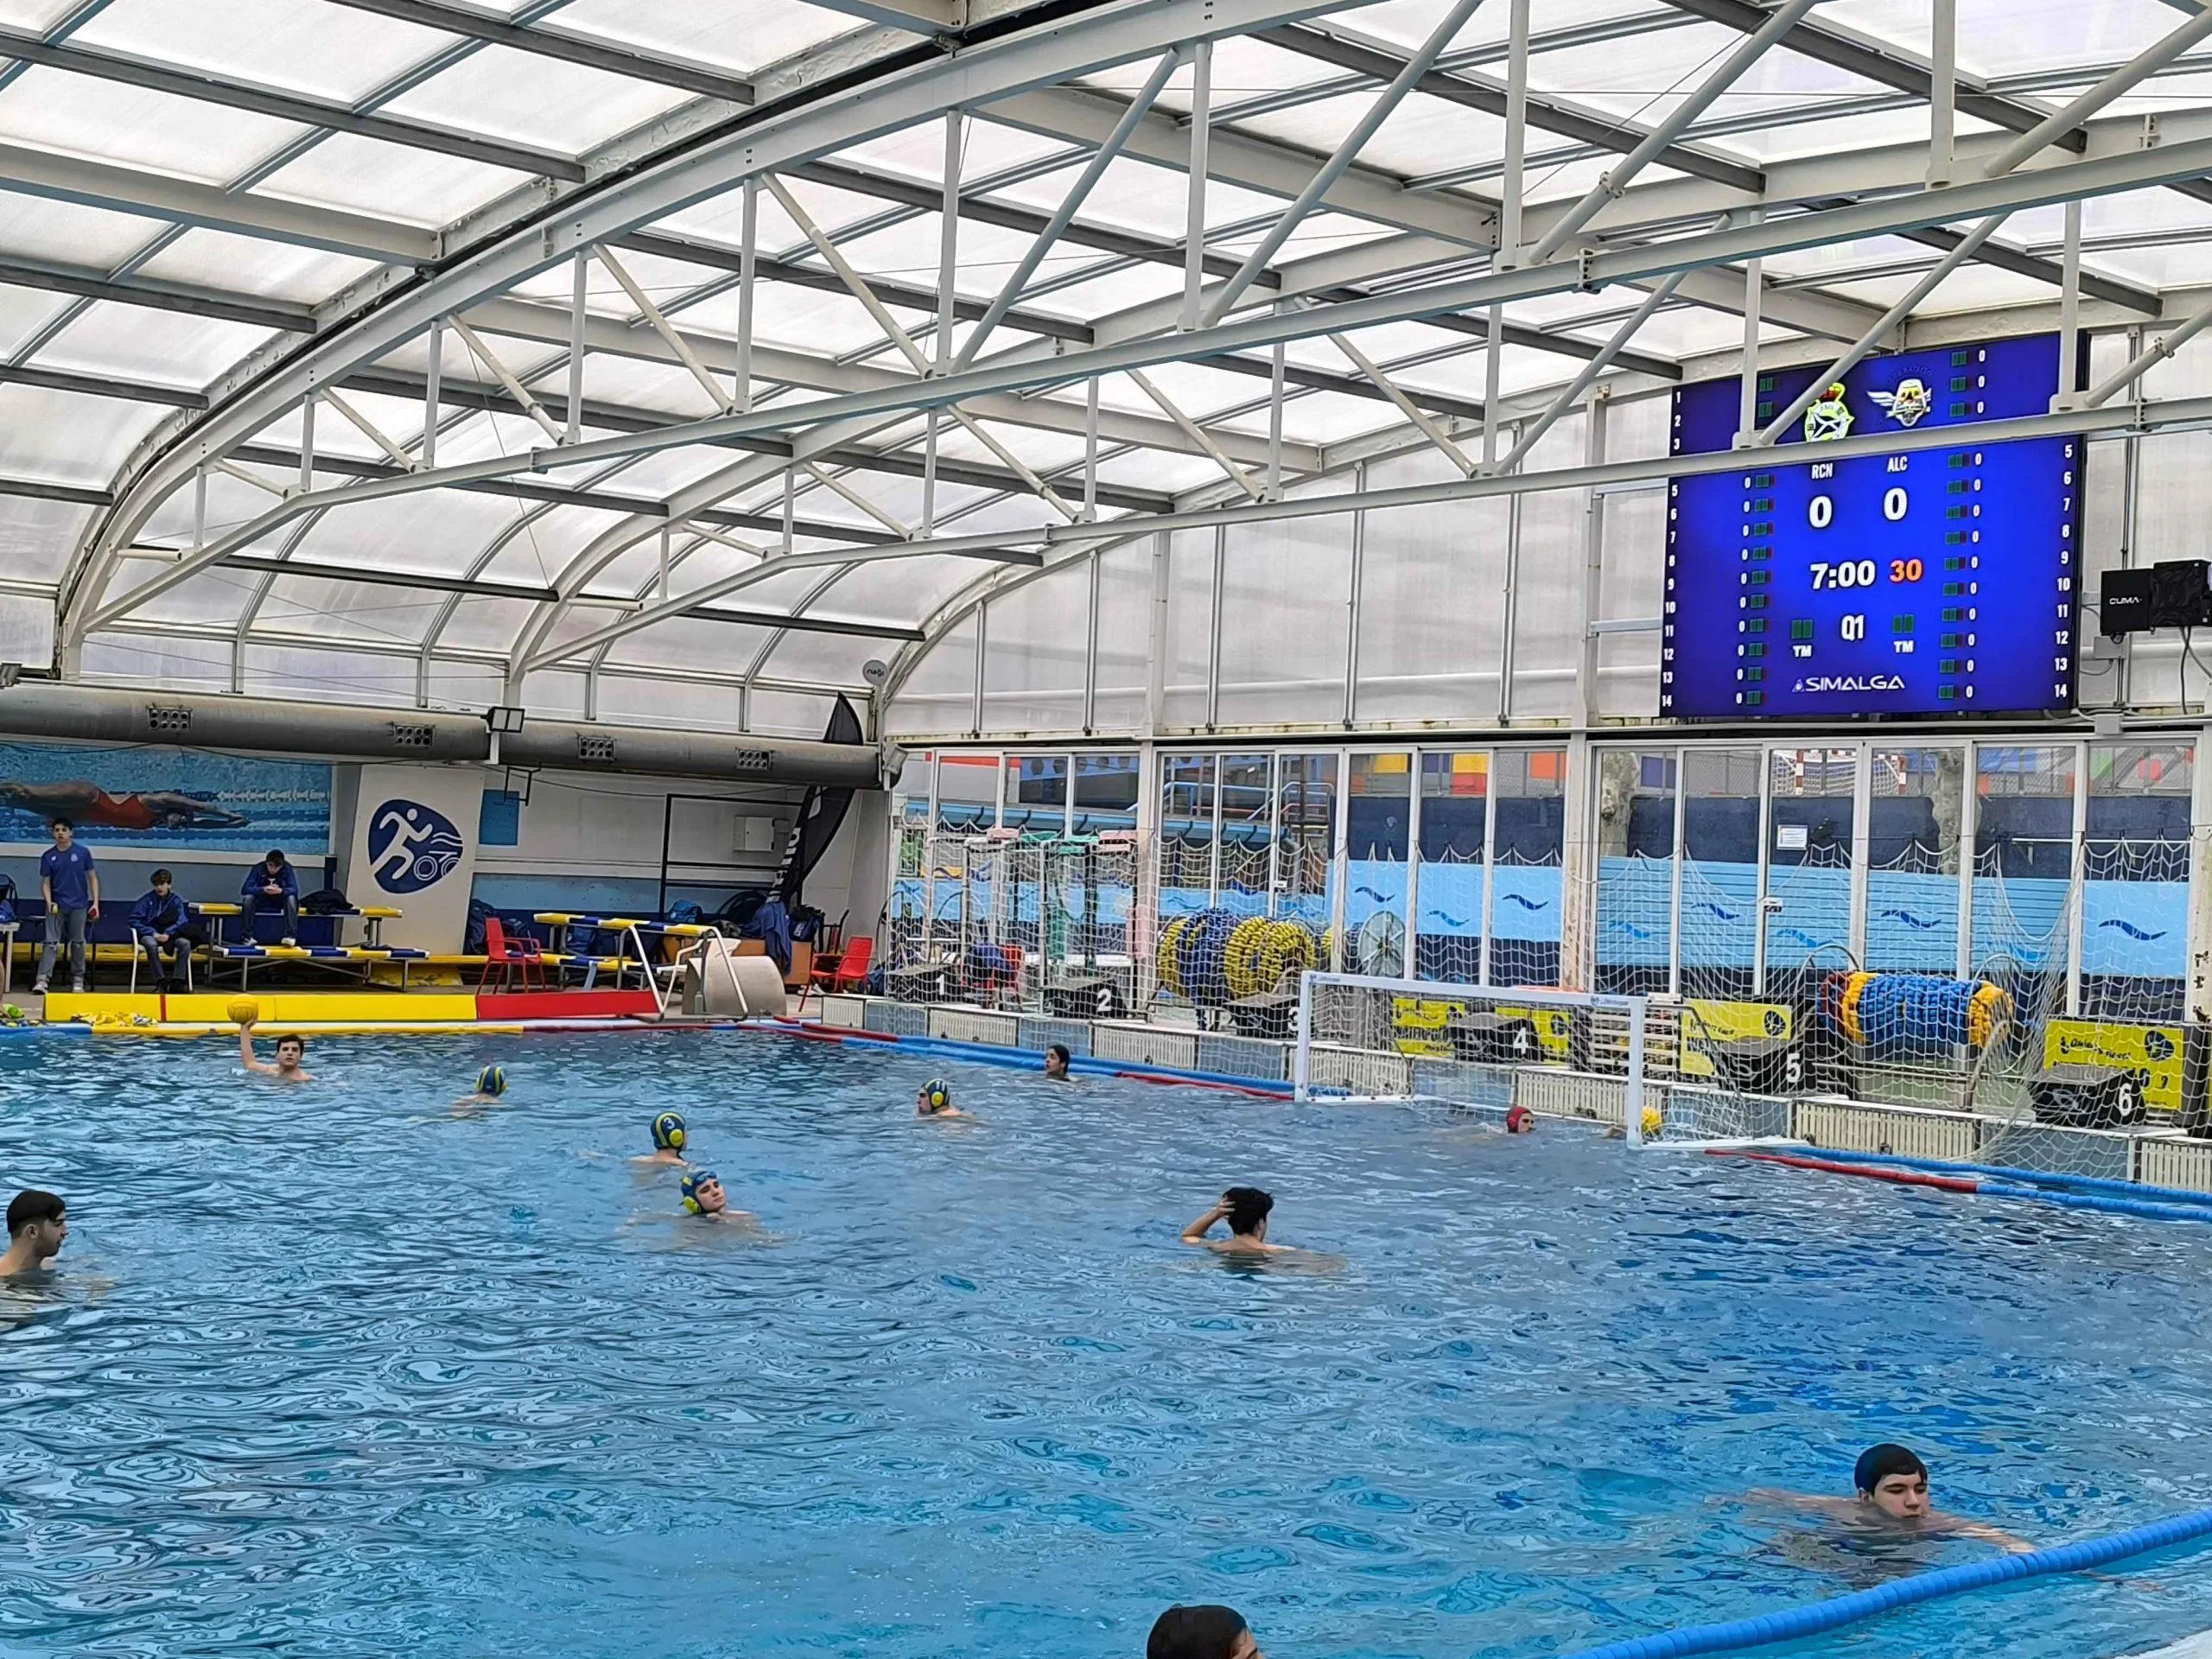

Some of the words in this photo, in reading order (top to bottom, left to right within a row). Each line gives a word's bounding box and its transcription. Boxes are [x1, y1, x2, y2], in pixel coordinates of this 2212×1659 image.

[1978, 349, 1986, 362] 0
[1978, 375, 1986, 388] 0
[1675, 391, 1681, 404] 1
[1977, 401, 1985, 414] 0
[1674, 414, 1681, 428] 2
[1673, 437, 1681, 450] 3
[2064, 444, 2073, 459] 5
[1886, 455, 1908, 473] ALC
[1974, 453, 1982, 466] 0
[1811, 462, 1834, 480] RCN
[1745, 477, 1751, 489] 0
[1974, 479, 1981, 491] 0
[2063, 471, 2072, 486] 6
[1671, 484, 1678, 497] 5
[1743, 500, 1751, 512] 0
[1884, 487, 1908, 520] 0
[2063, 497, 2071, 512] 7
[1670, 507, 1677, 520] 6
[1808, 495, 1833, 528] 0
[1973, 504, 1980, 517] 0
[1669, 531, 1676, 543] 7
[1742, 524, 1750, 537] 0
[1972, 531, 1980, 543] 0
[2062, 524, 2070, 538] 8
[1669, 554, 1675, 567] 8
[1741, 549, 1748, 561] 0
[2061, 550, 2069, 564] 9
[1971, 556, 1979, 569] 0
[1809, 560, 1876, 589] 7:00
[1889, 558, 1923, 582] 30
[1668, 577, 1675, 591] 9
[1740, 572, 1747, 585] 0
[2056, 577, 2071, 592] 10
[1969, 582, 1977, 594] 0
[1665, 601, 1676, 613] 10
[1739, 596, 1746, 608] 0
[1968, 607, 1976, 620] 0
[2056, 604, 2069, 618] 11
[1664, 624, 1675, 637] 11
[1738, 620, 1745, 632] 0
[1841, 614, 1865, 641] Q1
[1967, 633, 1975, 646] 0
[2055, 630, 2069, 645] 12
[1738, 645, 1745, 657] 0
[1792, 645, 1812, 658] TM
[1893, 639, 1914, 653] TM
[1663, 647, 1675, 661] 12
[1967, 659, 1974, 672] 0
[2054, 657, 2068, 671] 13
[1662, 671, 1674, 683] 13
[1737, 668, 1744, 680] 0
[1805, 675, 1905, 692] SIMALGA
[1966, 685, 1974, 698] 0
[2054, 683, 2068, 698] 14
[1662, 694, 1673, 707] 14
[1735, 692, 1743, 704] 0
[935, 974, 945, 995] 1
[1096, 988, 1113, 1012] 2
[1287, 1006, 1300, 1032] 3
[1513, 1027, 1529, 1055] 4
[1785, 1052, 1802, 1084] 5
[2118, 1082, 2133, 1117] 6
[663, 1116, 676, 1130] 3
